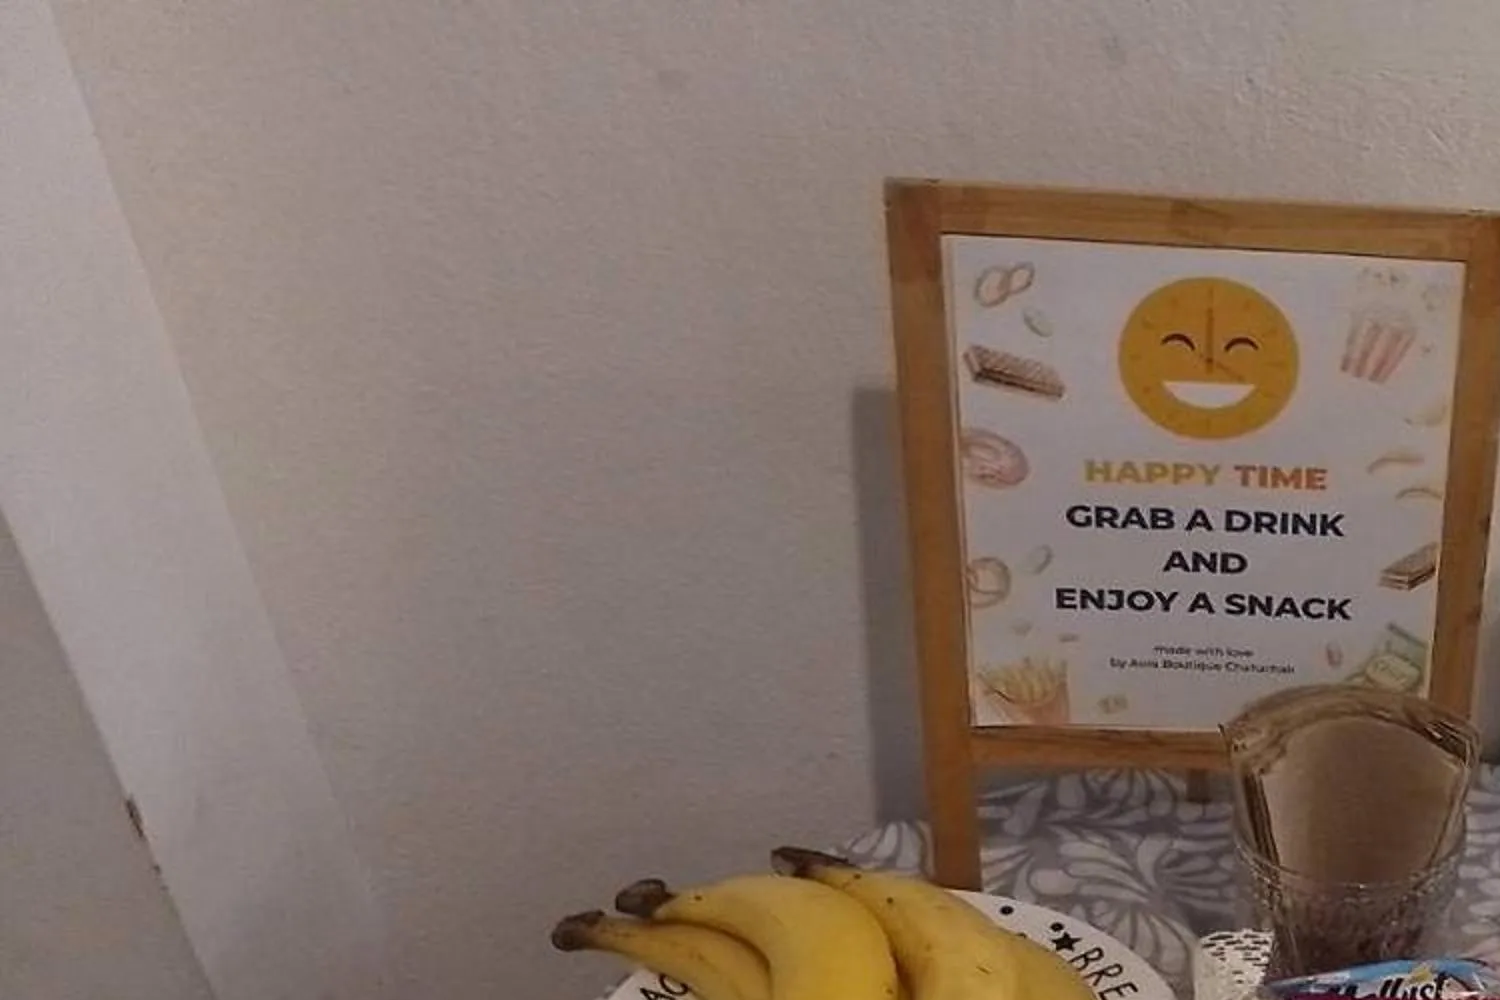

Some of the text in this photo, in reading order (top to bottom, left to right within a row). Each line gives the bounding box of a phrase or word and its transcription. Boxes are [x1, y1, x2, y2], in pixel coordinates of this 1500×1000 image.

[1084, 459, 1329, 491] HAPPY TIME
[1065, 504, 1346, 537] GRAB A DRINK
[1162, 550, 1249, 575] AND
[1055, 587, 1352, 621] ENJOY A SNACK
